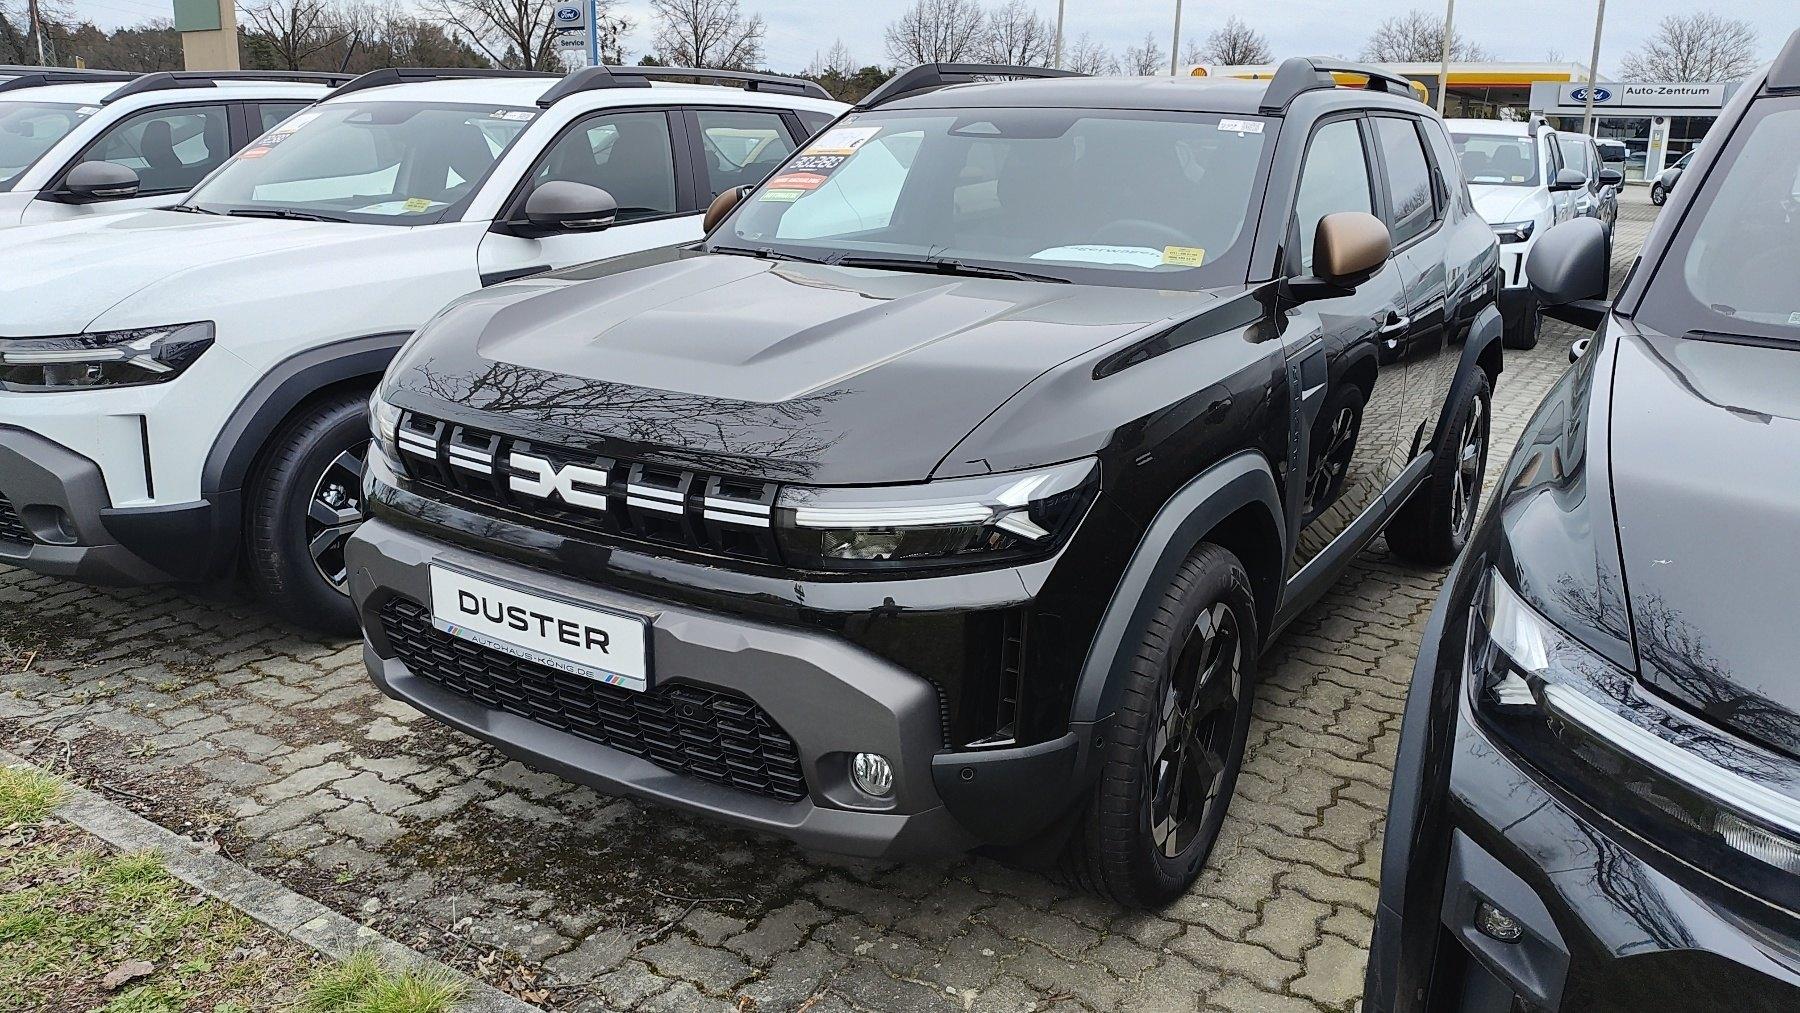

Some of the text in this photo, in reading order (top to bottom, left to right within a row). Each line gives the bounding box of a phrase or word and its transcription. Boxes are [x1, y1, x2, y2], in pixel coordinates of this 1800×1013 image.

[1625, 86, 1710, 95] Auto-Zentrum
[458, 589, 610, 654] DUSTER
[471, 635, 595, 679] AUTOHAUS-KÖNIG.DE
